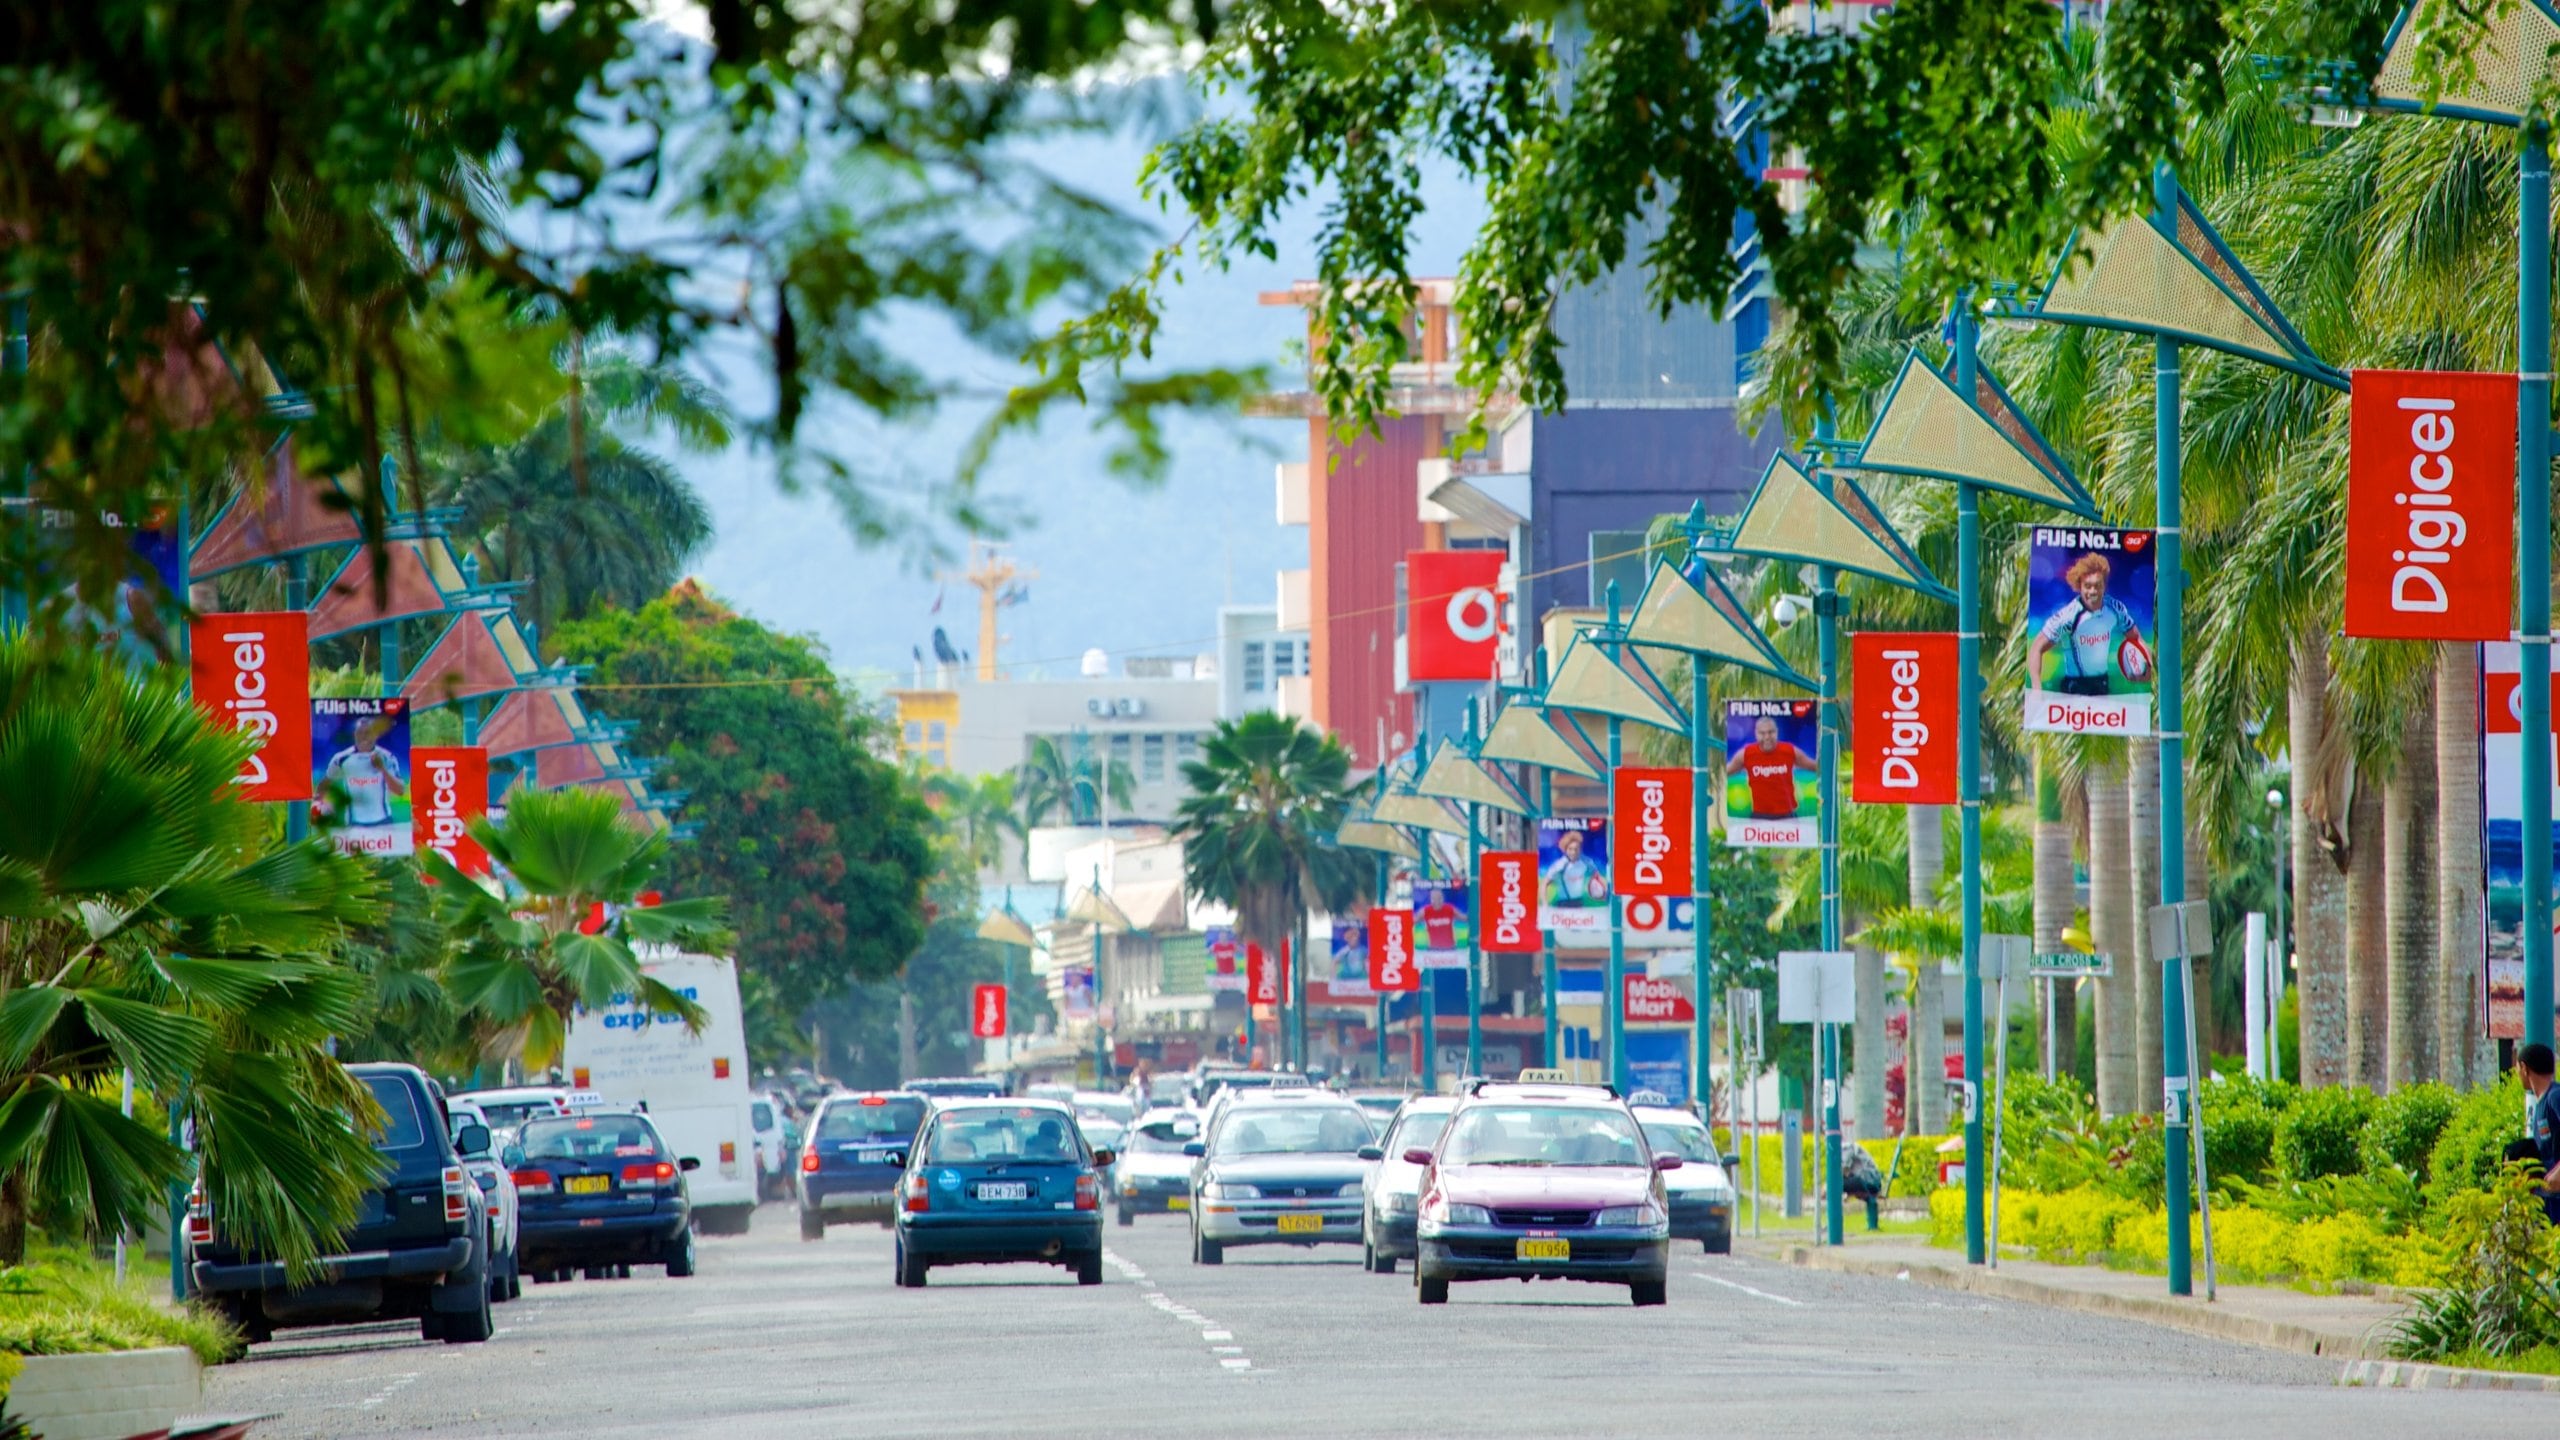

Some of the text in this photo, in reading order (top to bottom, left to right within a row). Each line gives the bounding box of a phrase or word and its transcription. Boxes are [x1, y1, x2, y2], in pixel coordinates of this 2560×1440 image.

[2391, 397, 2467, 613] Digicel
[2079, 530, 2121, 550] No.1
[2079, 632, 2110, 646] Digicel
[350, 700, 382, 714] No.1
[1763, 702, 1792, 716] No.1
[1882, 650, 1929, 788] Digicel
[2048, 705, 2126, 731] Digicel
[1751, 764, 1788, 778] Digicel
[1635, 780, 1671, 885] Digicel
[1744, 828, 1800, 843] Digicel
[1496, 861, 1527, 944] Digicel
[1551, 914, 1594, 929] Digicel
[1382, 915, 1407, 985] Digicel
[1628, 999, 1675, 1017] Mart
[1528, 1072, 1563, 1082] TAXI
[572, 1095, 599, 1104] TAXI
[1635, 1095, 1665, 1103] TAXI
